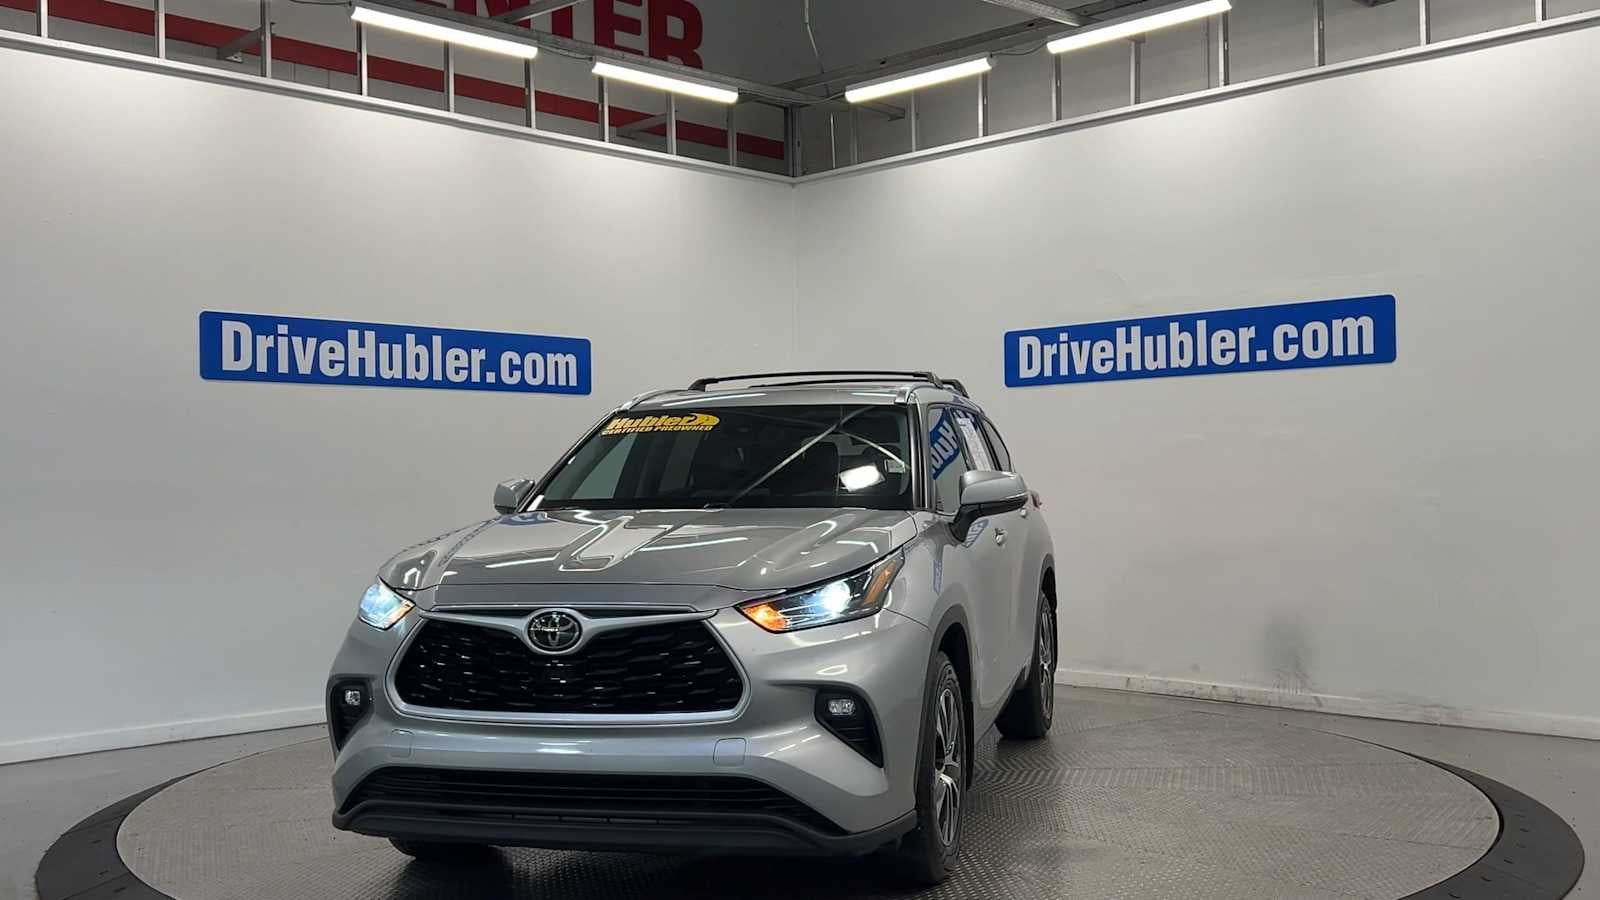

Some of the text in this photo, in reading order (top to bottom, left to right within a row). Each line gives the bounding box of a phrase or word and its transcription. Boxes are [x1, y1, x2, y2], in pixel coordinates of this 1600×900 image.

[221, 320, 578, 387] DriveHubler.com
[1018, 314, 1375, 379] DriveHubler.com
[606, 415, 697, 429] Hubler
